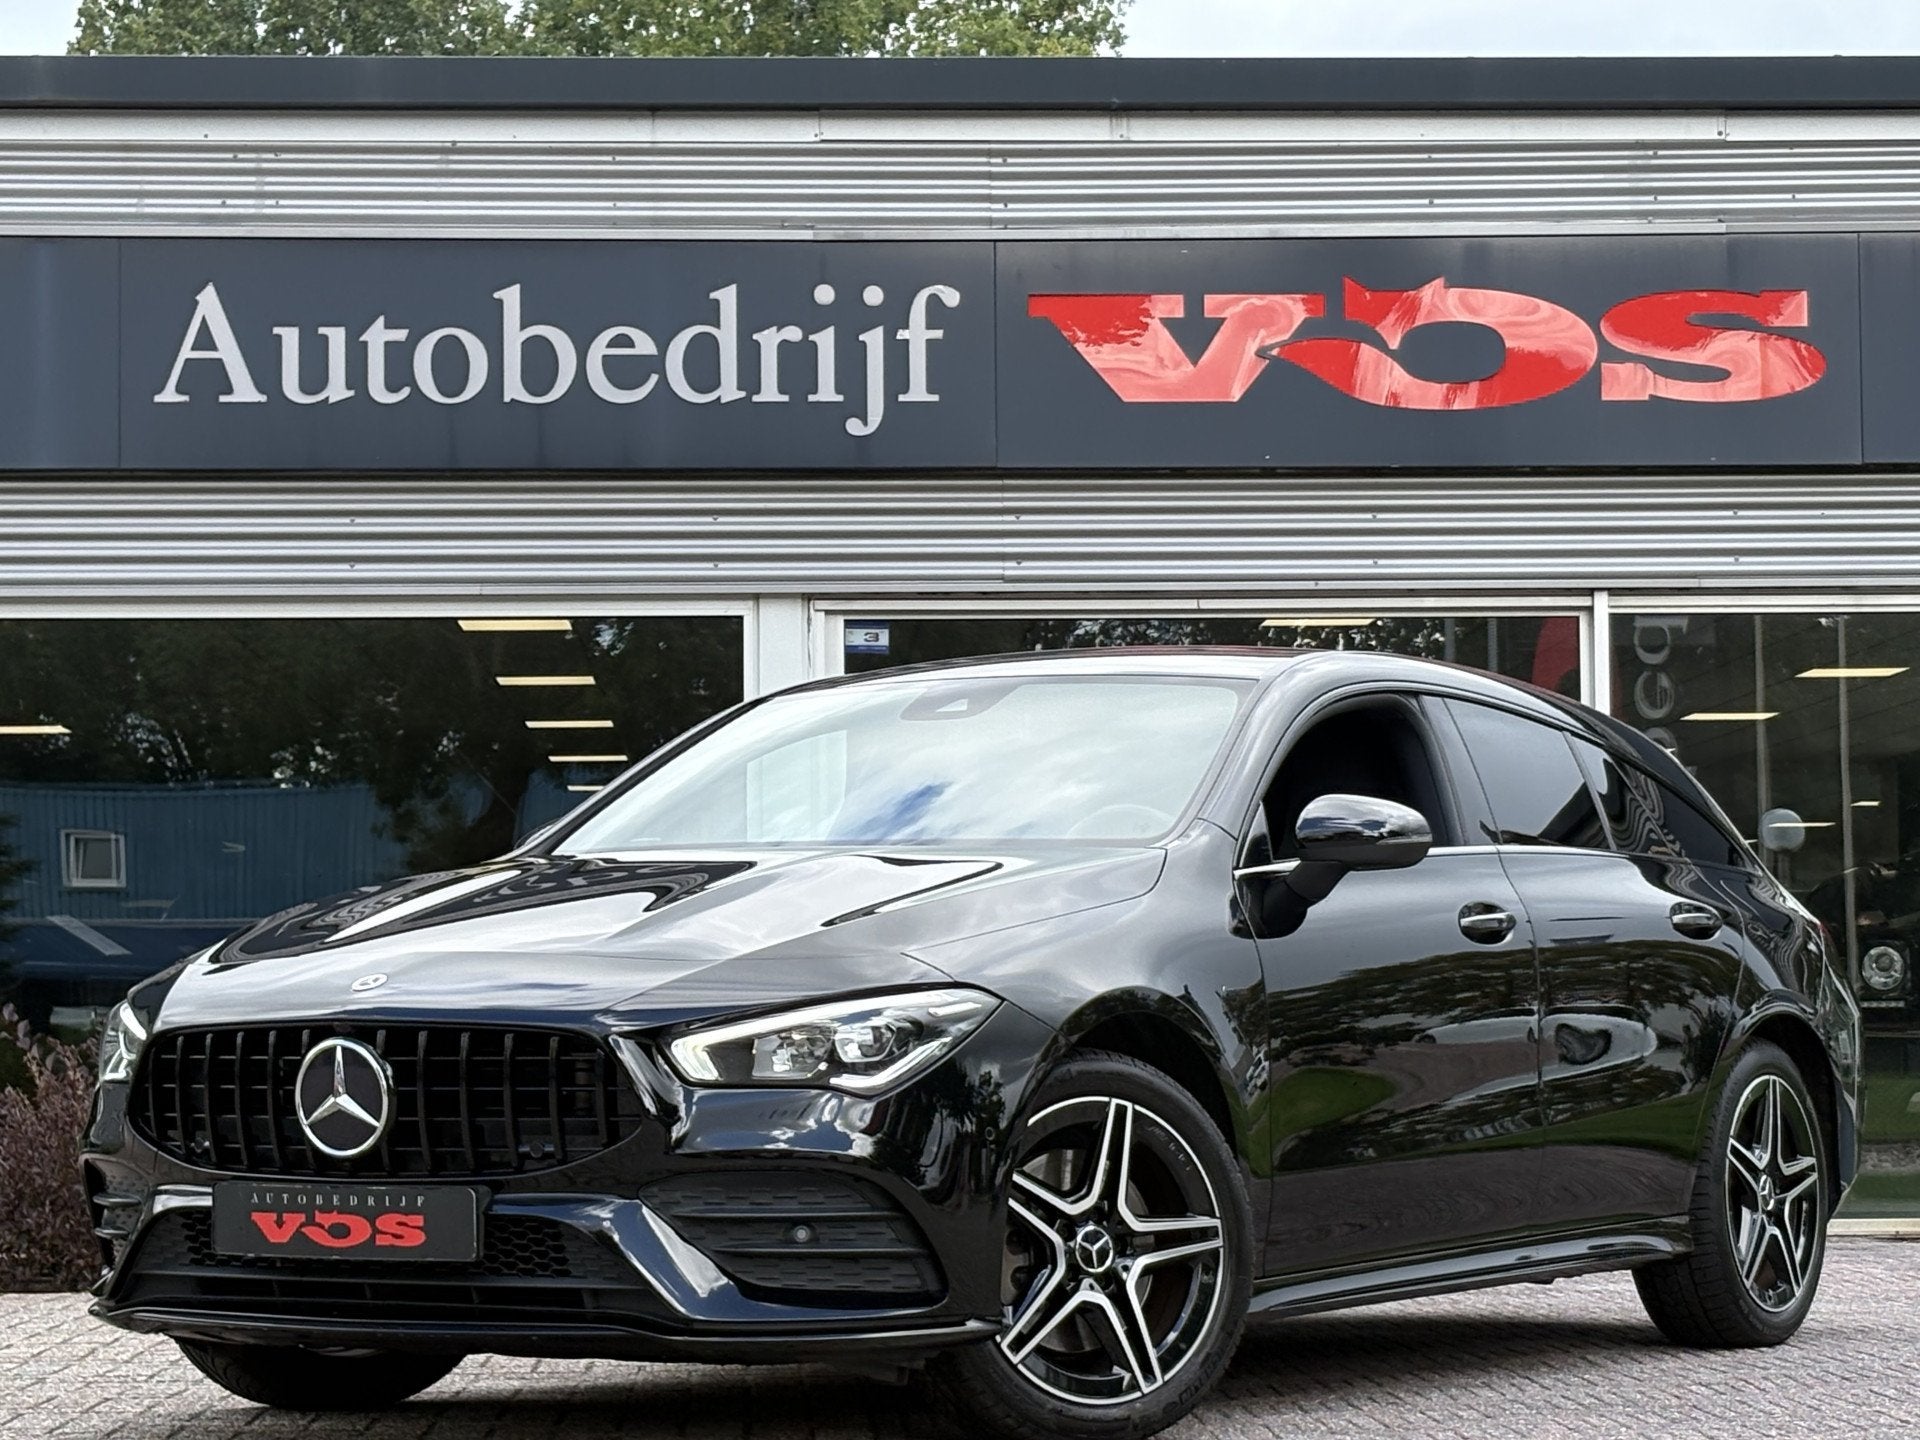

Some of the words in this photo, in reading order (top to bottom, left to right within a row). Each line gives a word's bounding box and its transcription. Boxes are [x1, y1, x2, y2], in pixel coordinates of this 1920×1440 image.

[153, 282, 961, 437] Autobedrijf
[1027, 276, 1828, 411] VOS
[250, 1192, 426, 1208] AUTOBEDRIJF
[250, 1209, 428, 1249] VOS
